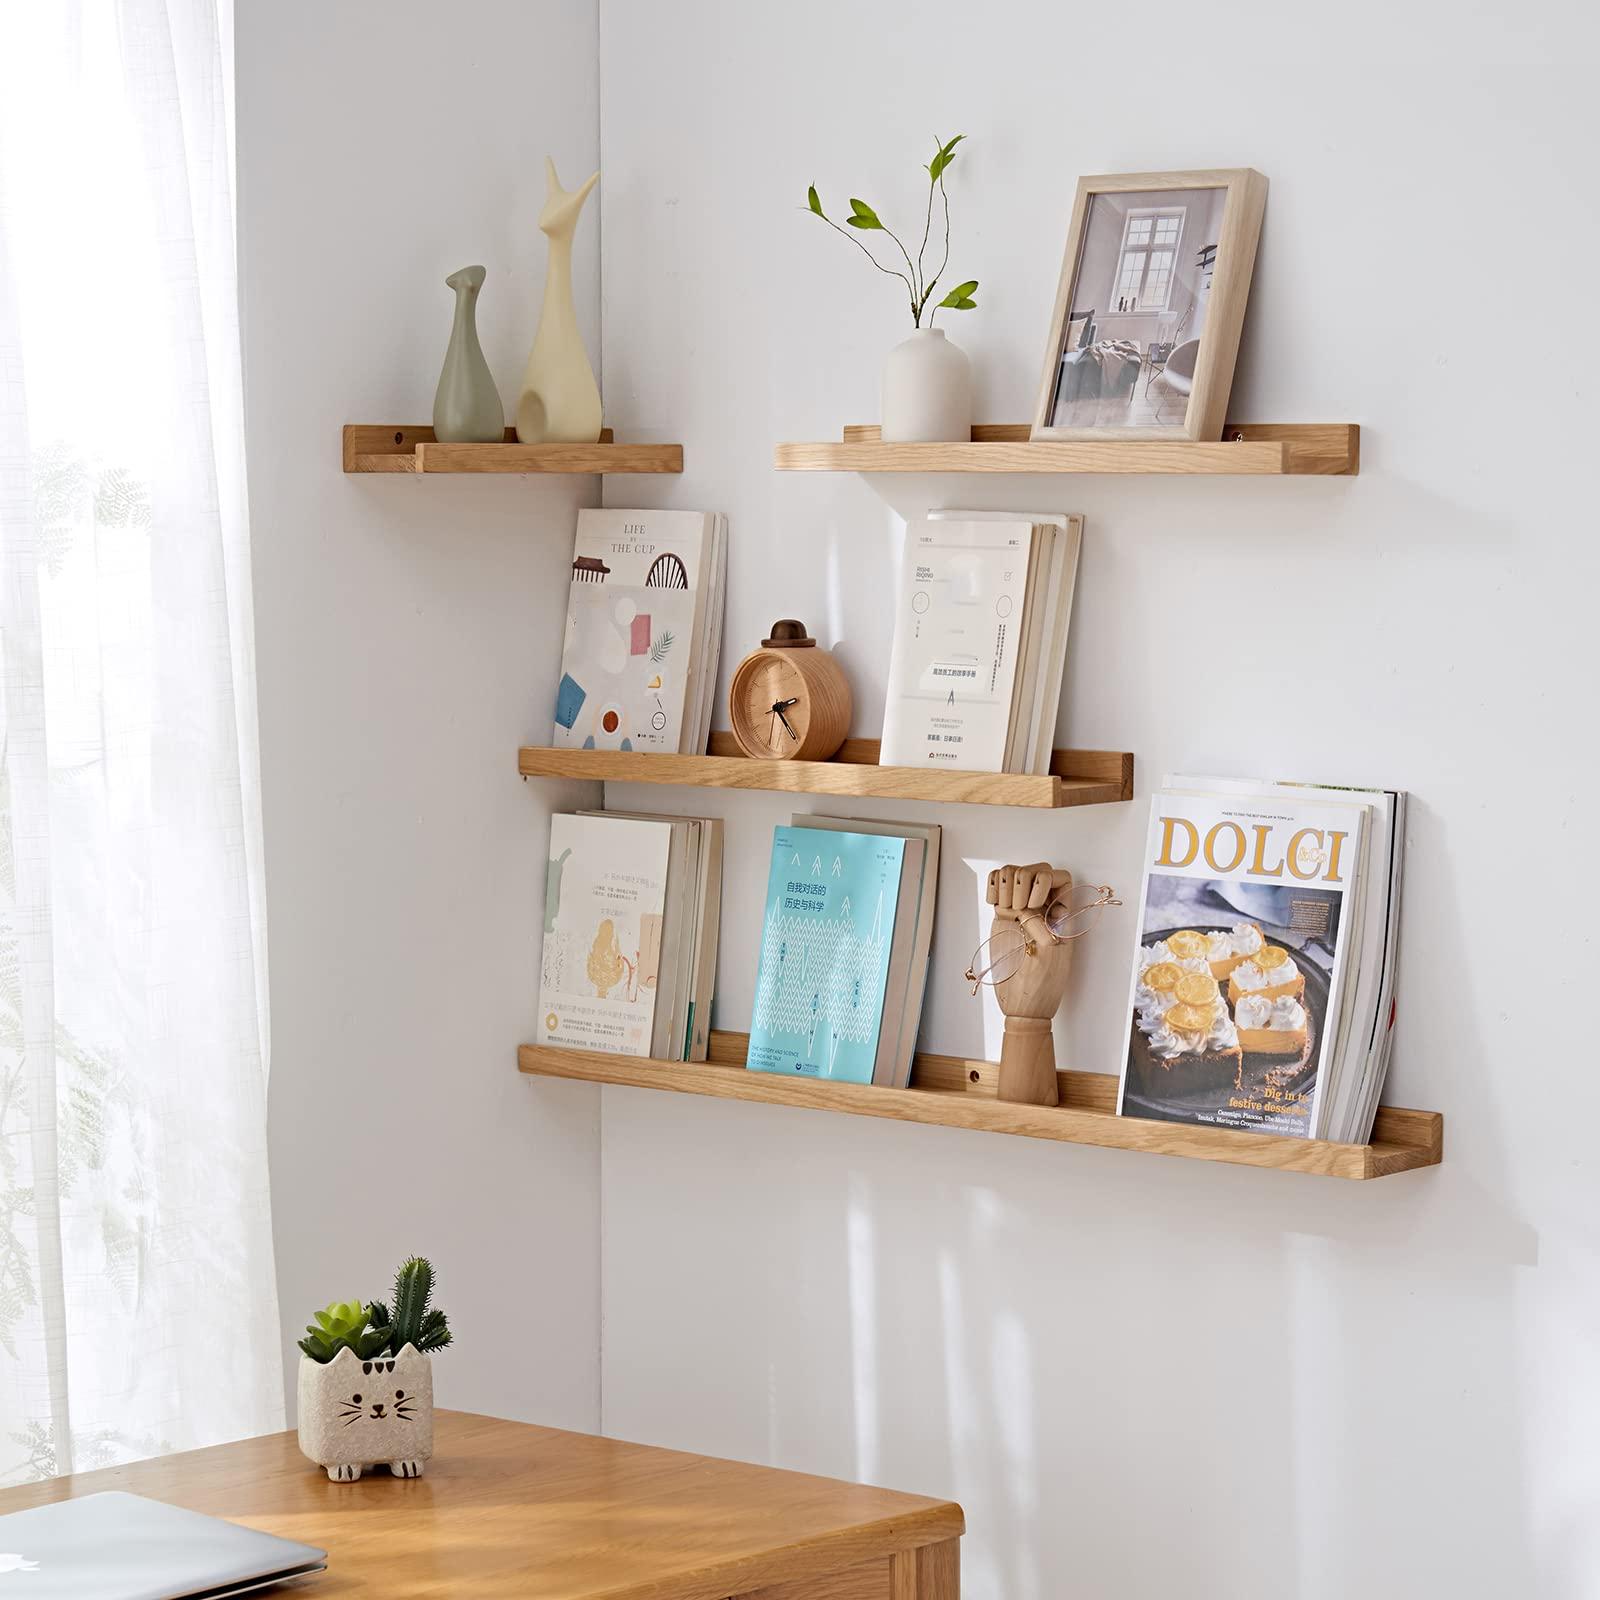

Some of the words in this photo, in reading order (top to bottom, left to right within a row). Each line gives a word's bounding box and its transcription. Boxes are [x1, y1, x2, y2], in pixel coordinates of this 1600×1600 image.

[624, 524, 646, 535] LIFE
[611, 543, 631, 553] THE
[634, 544, 656, 554] CUP
[1154, 816, 1349, 883] DOLCI
[786, 881, 827, 897] 自我对话的
[784, 897, 825, 912] 历史与科学
[1264, 1087, 1282, 1101] Dig
[1285, 1090, 1296, 1101] in
[1229, 1097, 1262, 1111] festive
